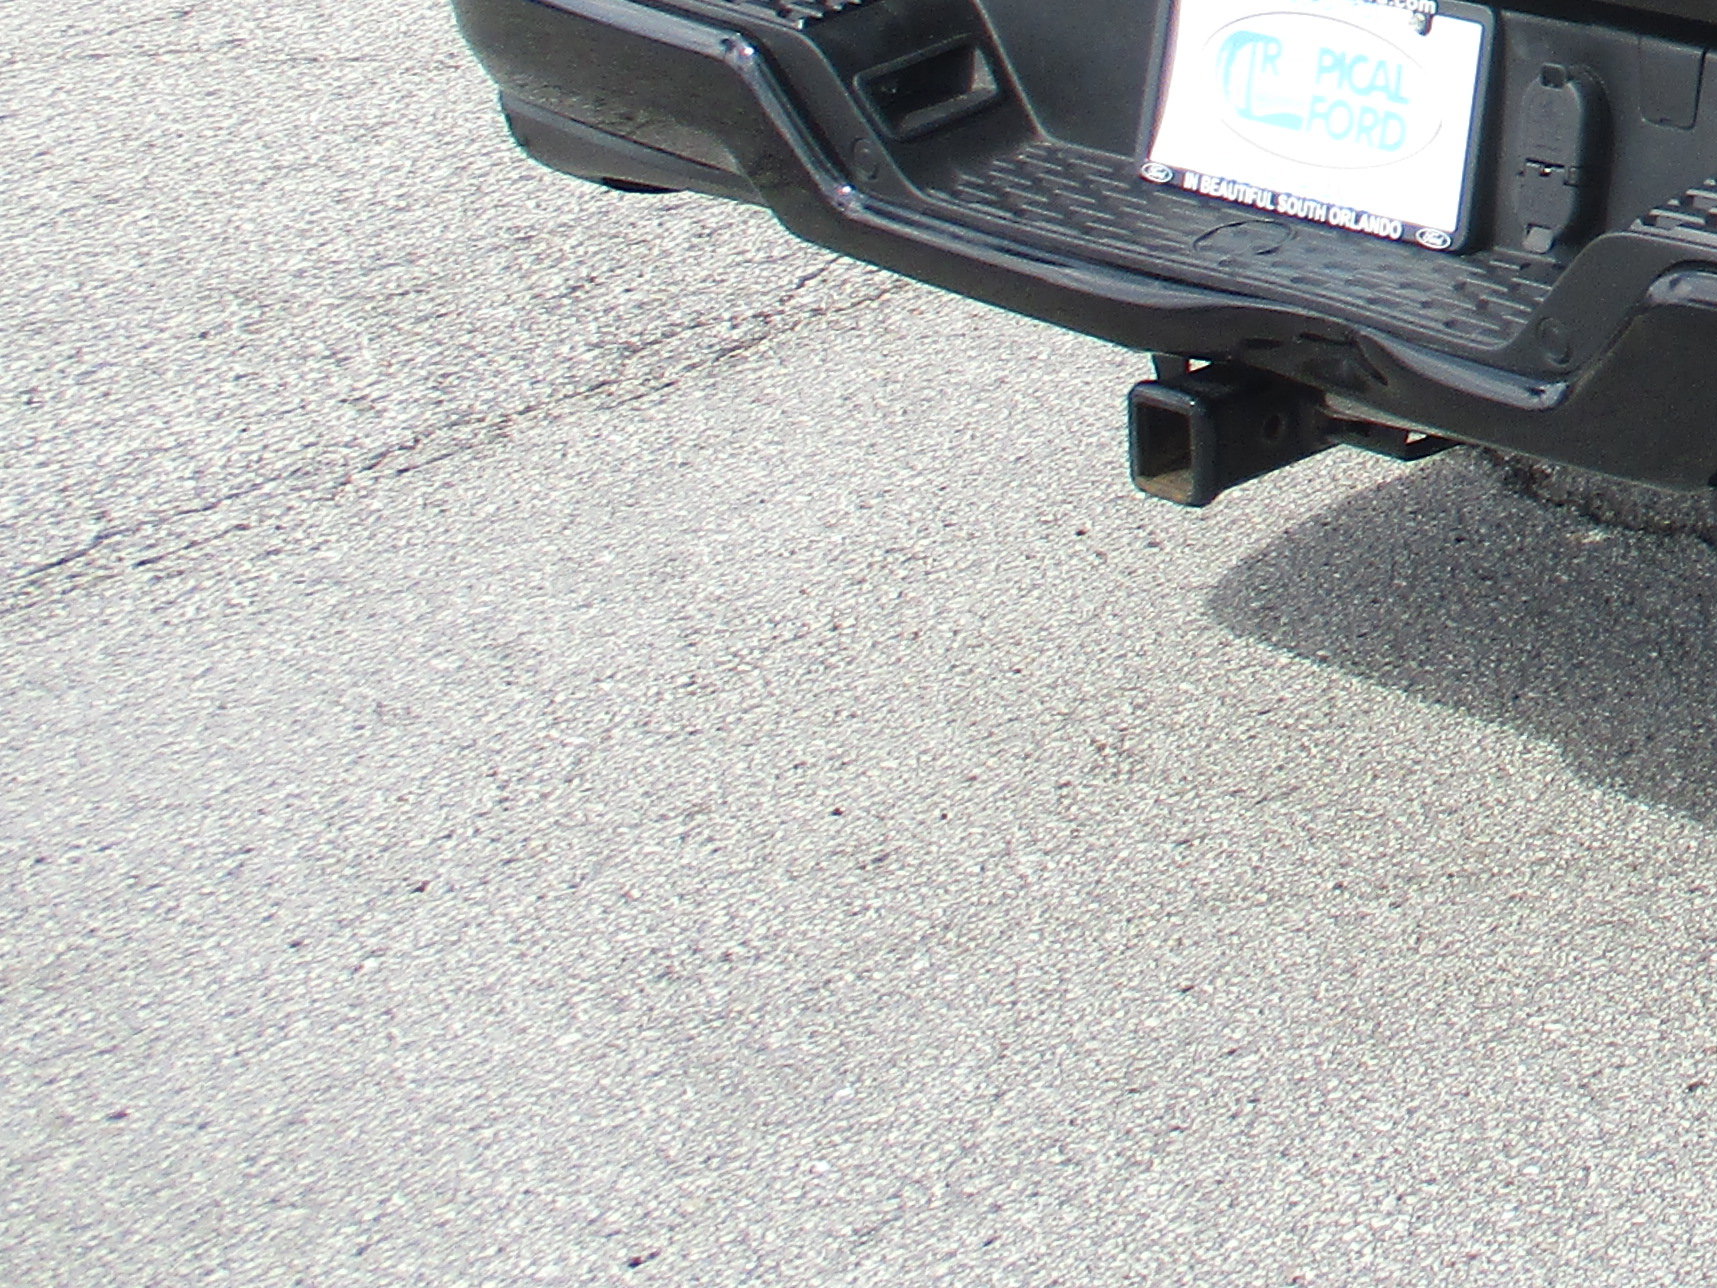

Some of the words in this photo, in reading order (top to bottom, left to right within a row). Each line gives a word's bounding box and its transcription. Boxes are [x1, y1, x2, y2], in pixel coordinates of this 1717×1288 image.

[1305, 94, 1408, 152] FORD
[1182, 170, 1200, 192] IN
[1199, 175, 1275, 210] BEAUTIFUL
[1276, 193, 1328, 223] SOUTH
[1328, 206, 1403, 240] ORLANDO
